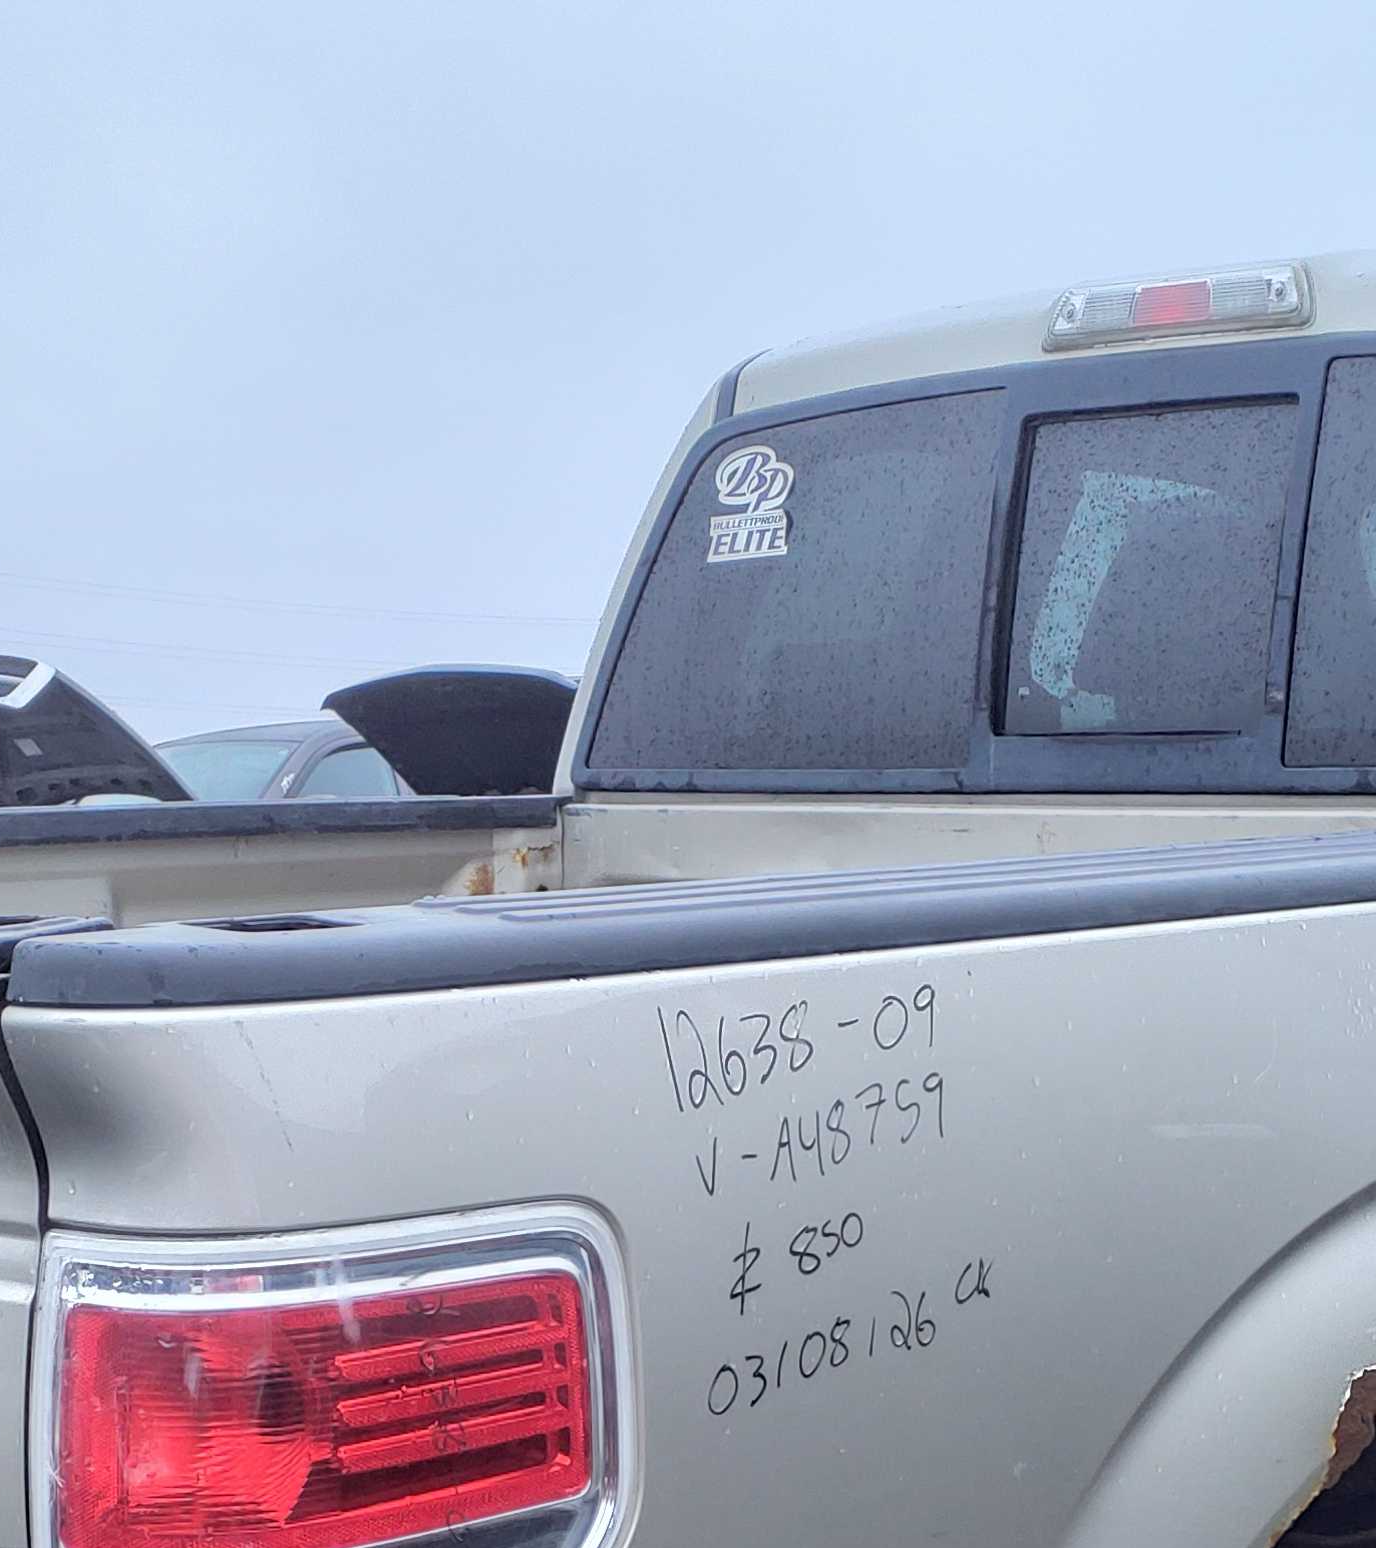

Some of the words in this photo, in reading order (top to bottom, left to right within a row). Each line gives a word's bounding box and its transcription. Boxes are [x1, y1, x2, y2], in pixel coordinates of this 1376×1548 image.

[711, 526, 785, 556] ELITE
[657, 984, 937, 1113] 12638-09
[789, 1212, 864, 1275] 850
